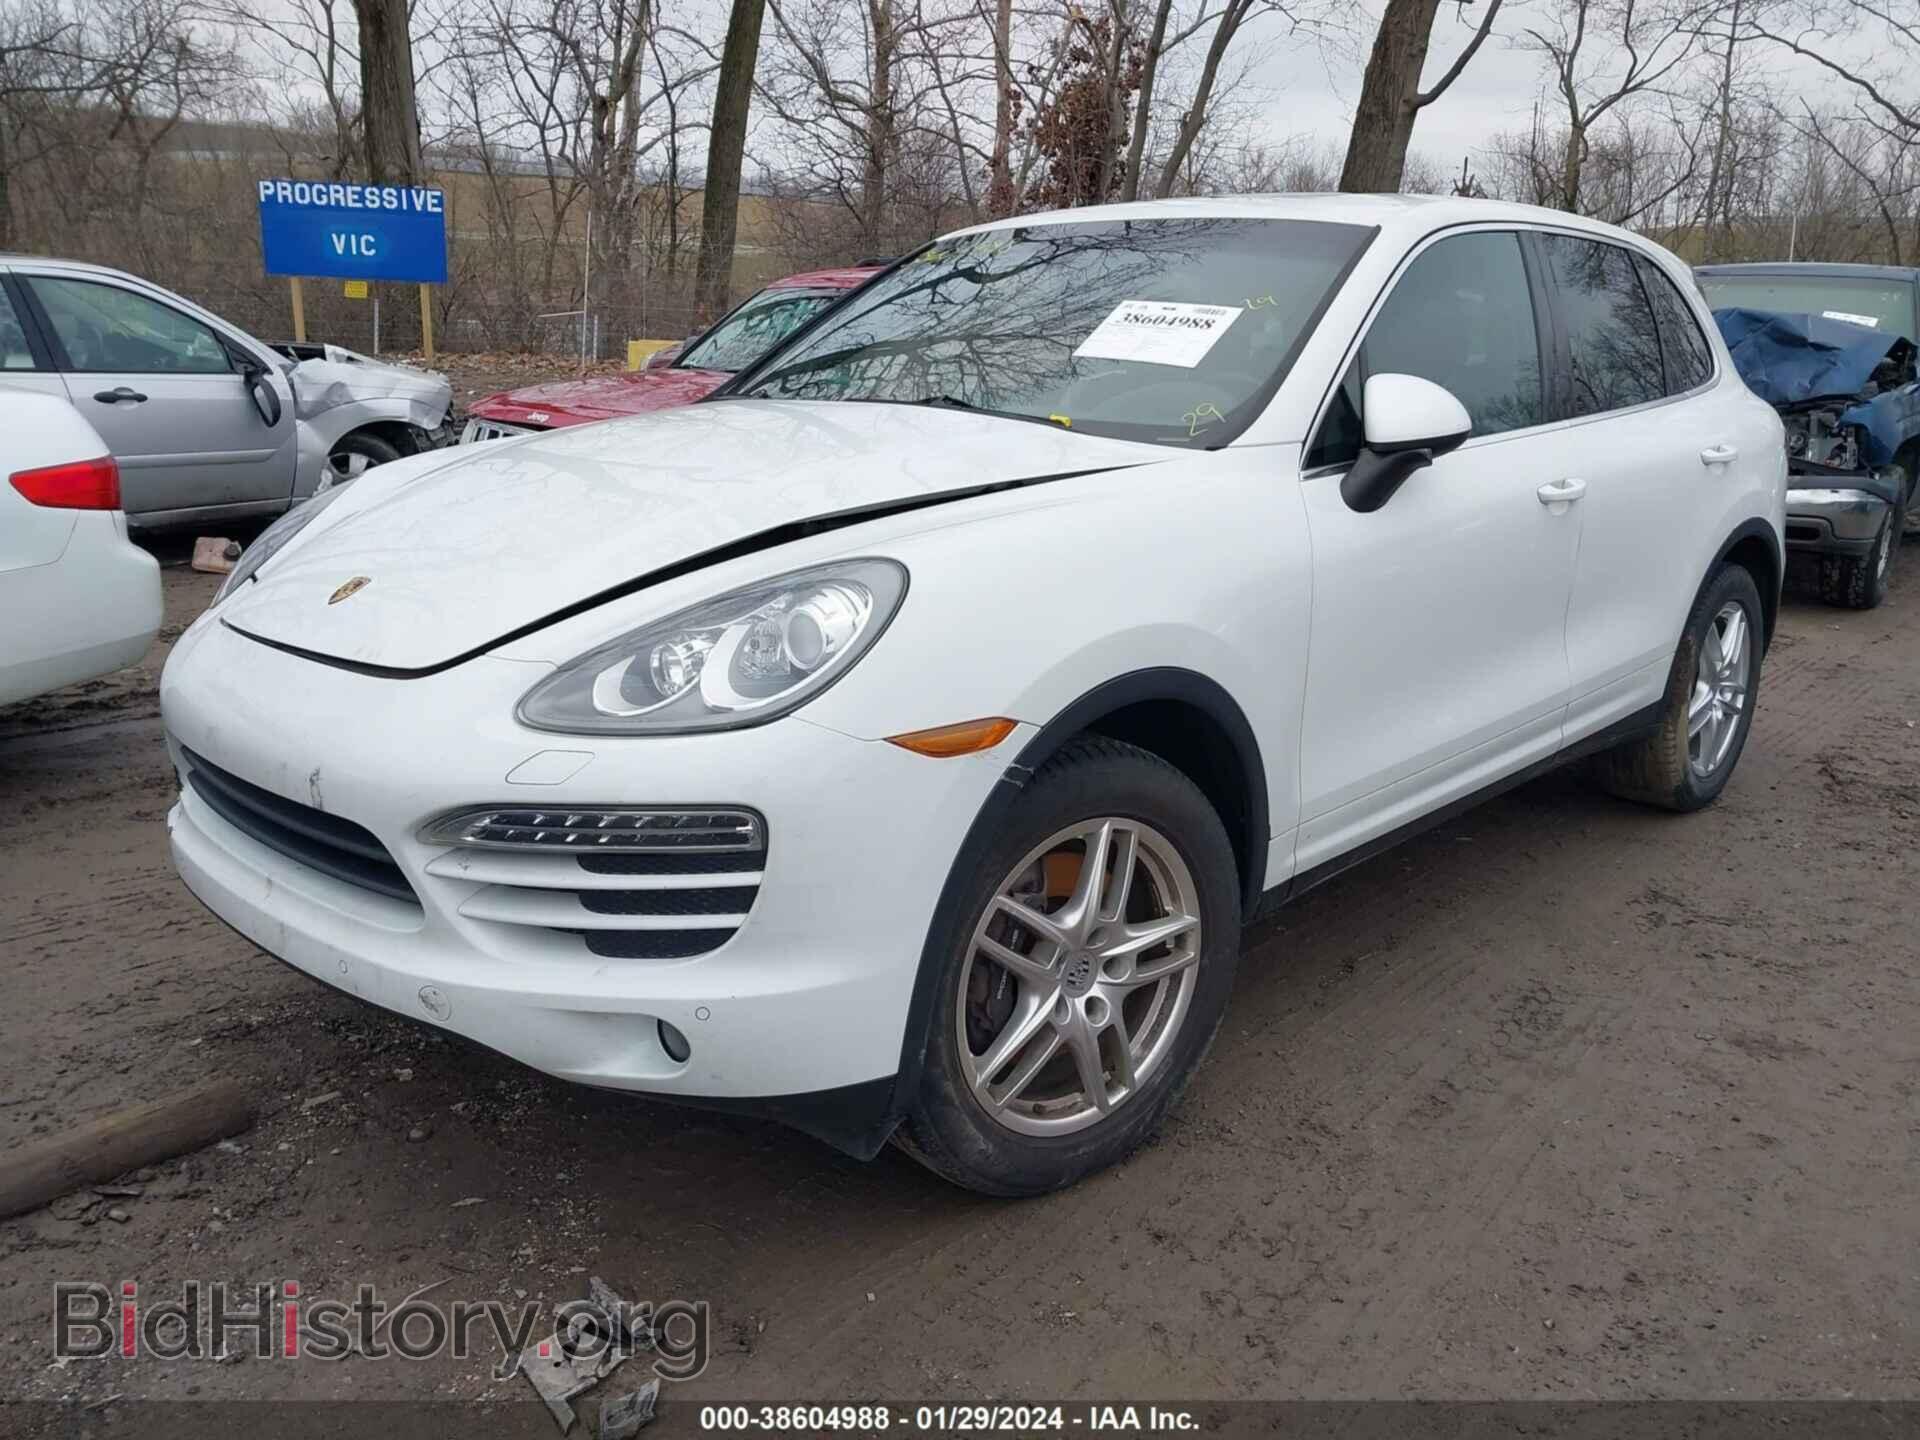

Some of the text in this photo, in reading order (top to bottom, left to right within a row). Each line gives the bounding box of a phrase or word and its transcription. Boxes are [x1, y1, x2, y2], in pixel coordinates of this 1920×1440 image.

[258, 181, 443, 213] PROGRESSIVE
[331, 233, 377, 256] VIC
[1123, 312, 1216, 330] 38604988
[1183, 402, 1226, 436] 29
